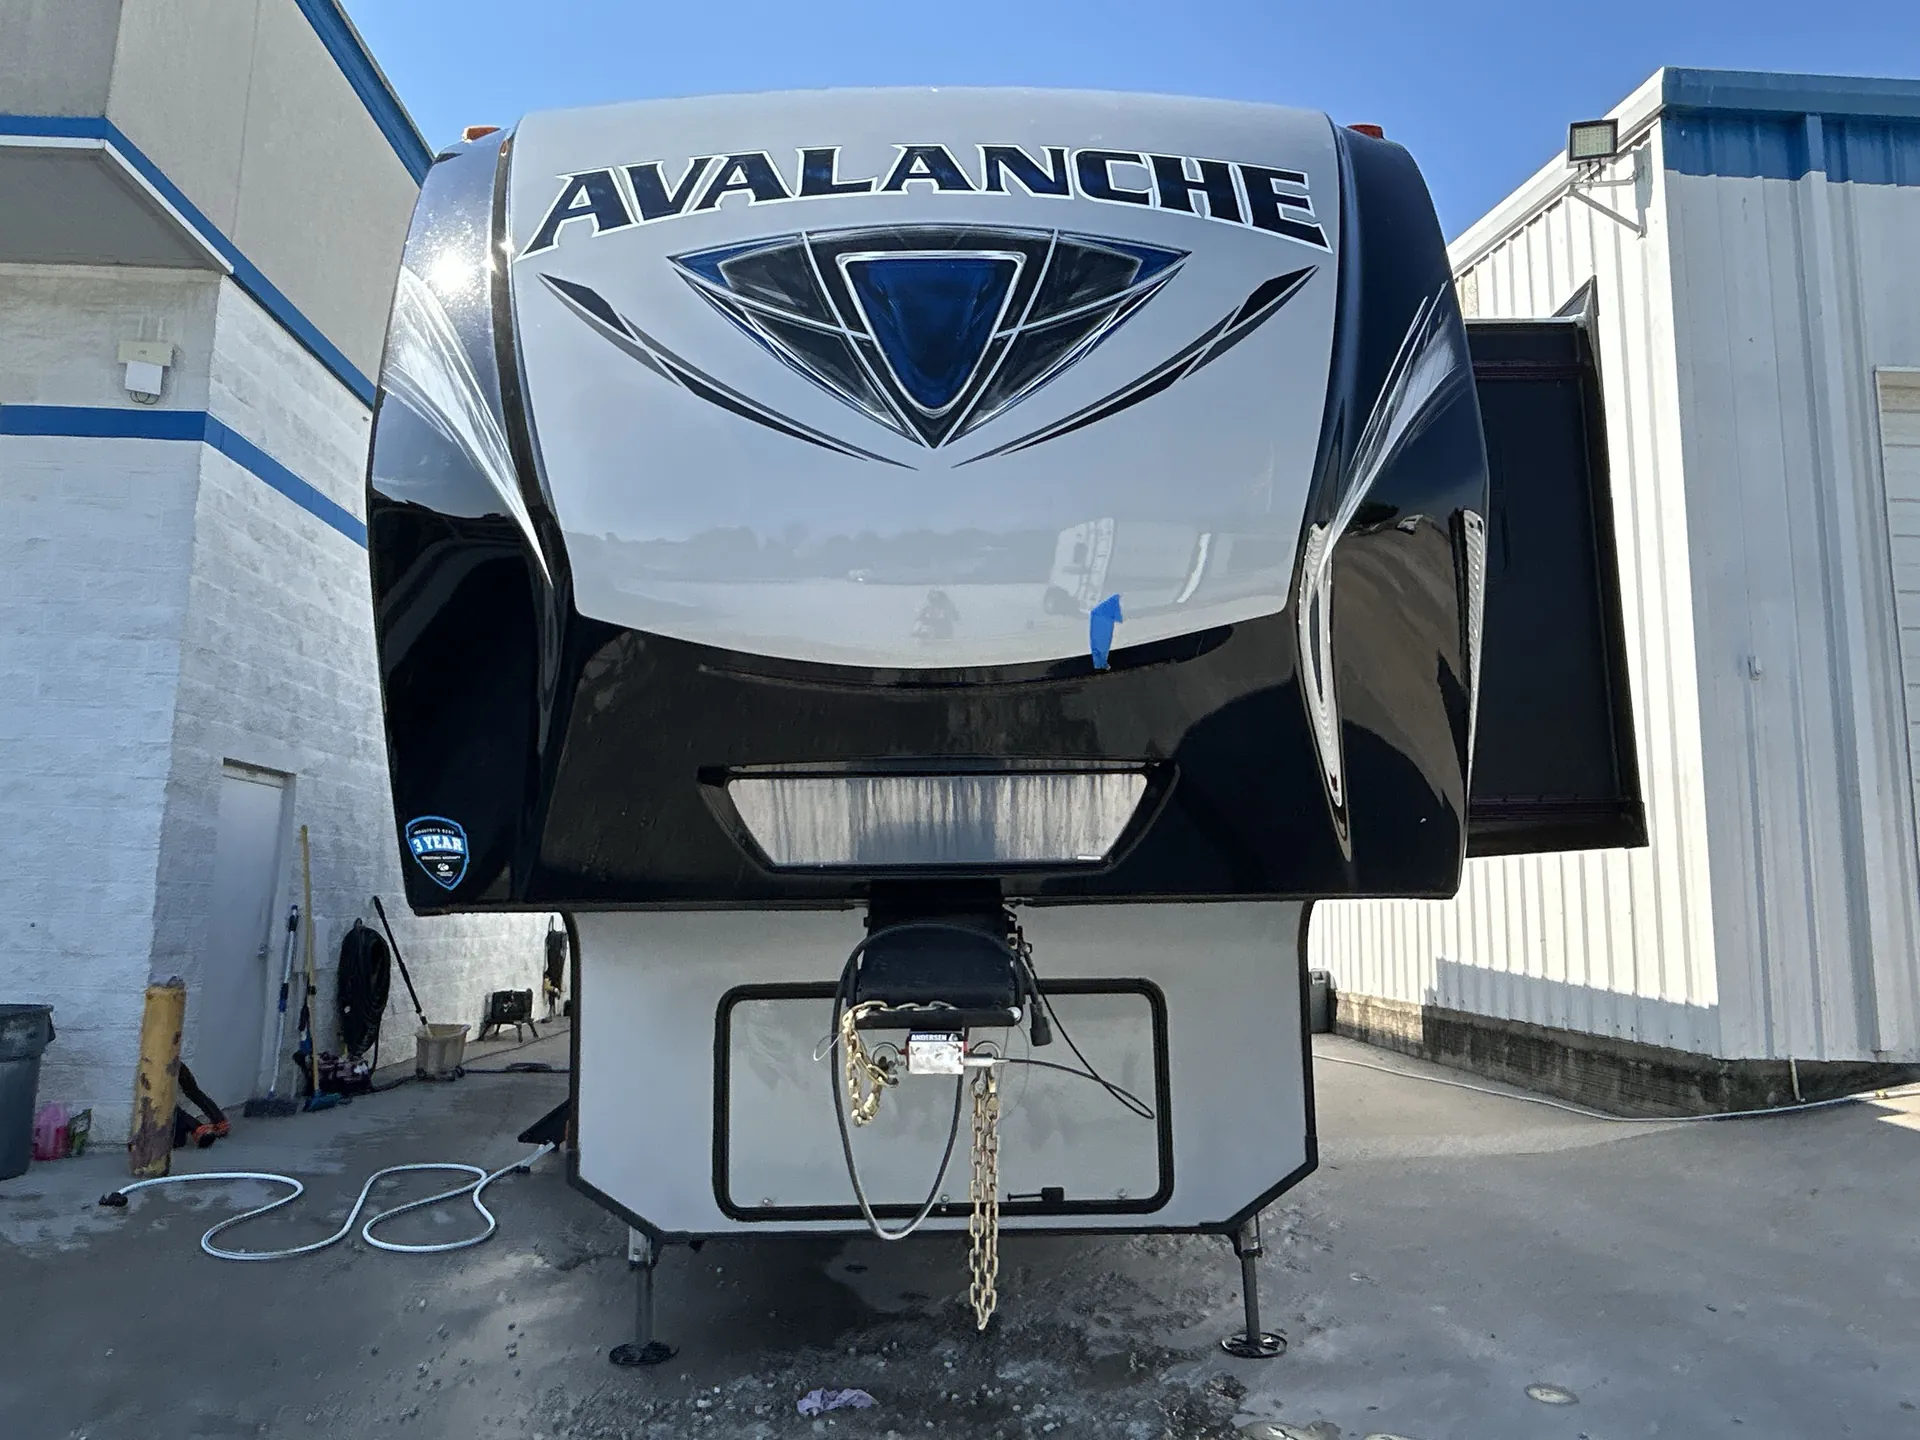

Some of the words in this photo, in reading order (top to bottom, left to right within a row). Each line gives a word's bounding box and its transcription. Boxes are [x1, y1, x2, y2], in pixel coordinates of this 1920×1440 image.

[515, 143, 1333, 260] AVALANCHE
[413, 838, 424, 853] 3
[423, 835, 464, 851] YEAR
